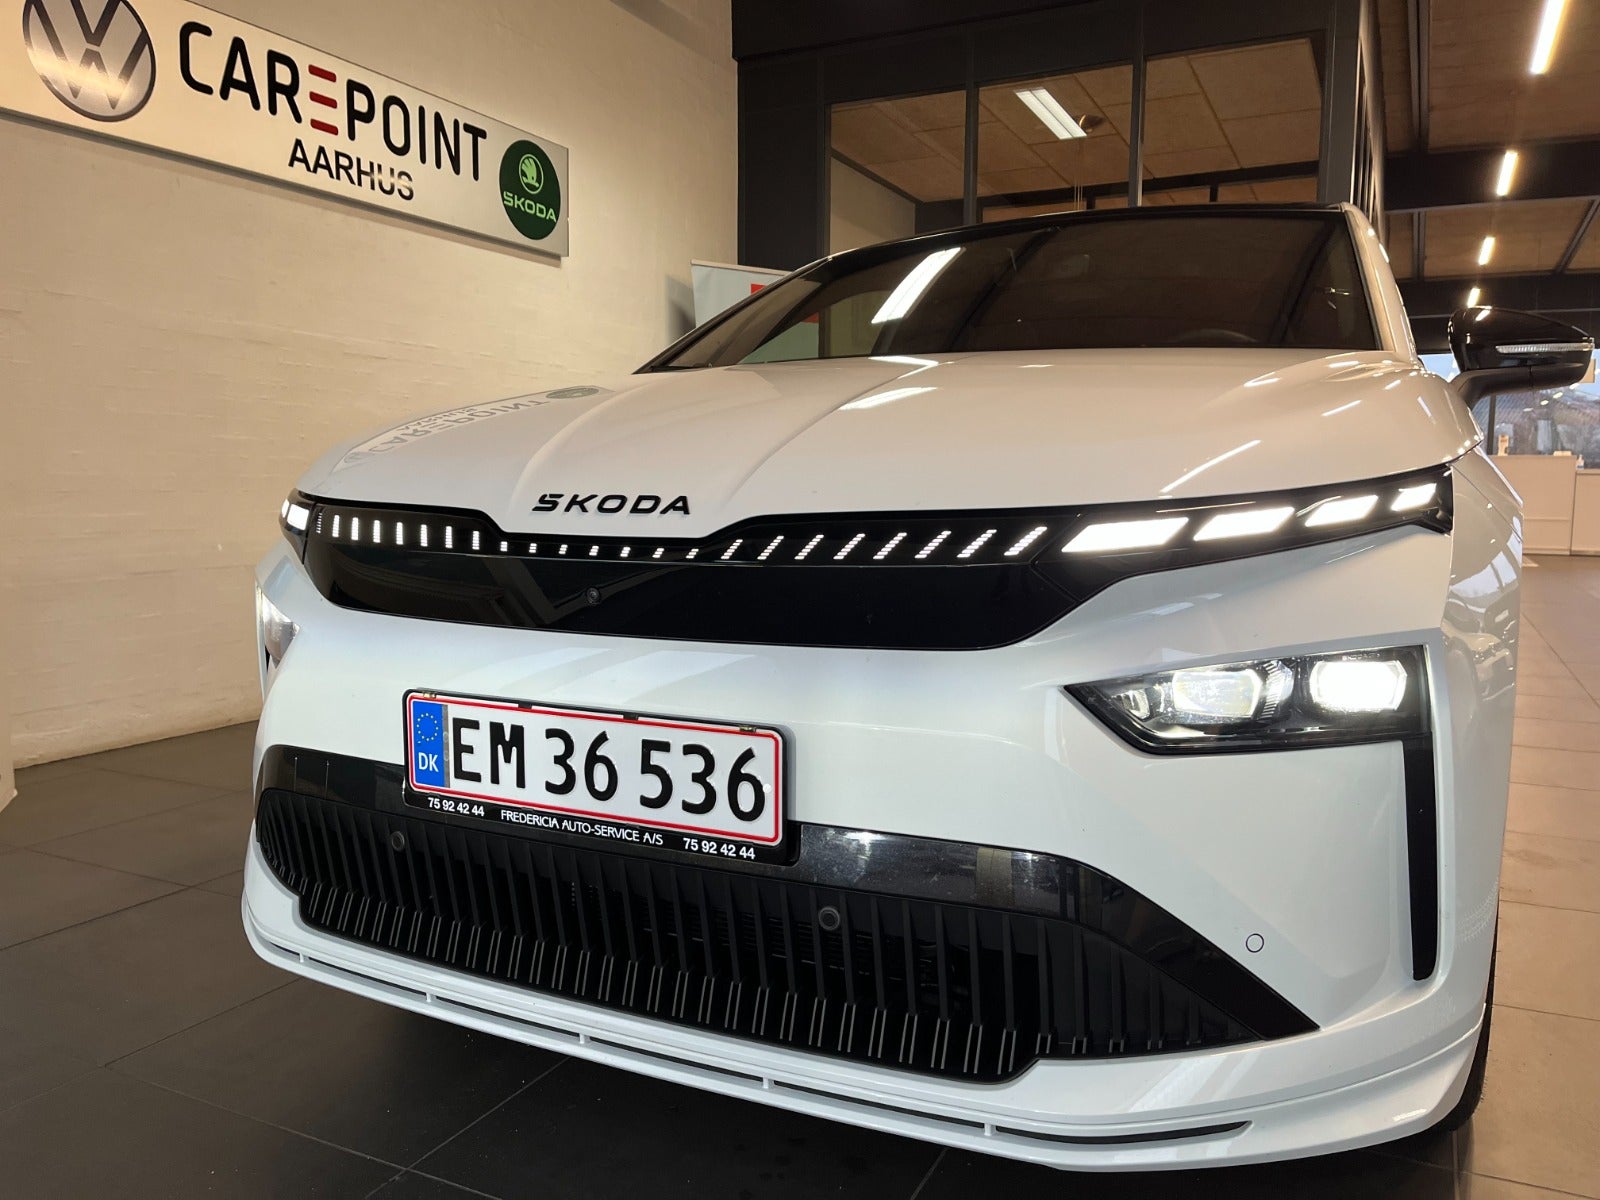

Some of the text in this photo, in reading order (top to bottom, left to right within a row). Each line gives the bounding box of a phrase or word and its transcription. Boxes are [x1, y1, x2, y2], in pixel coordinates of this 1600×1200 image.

[179, 21, 487, 182] CAREPOINT
[288, 138, 414, 201] AARHUS
[503, 191, 557, 223] SKODA
[531, 493, 691, 515] SKODA
[418, 751, 440, 773] DK
[452, 717, 766, 822] EM 36 536
[427, 797, 485, 817] 75 92 42 44
[501, 809, 664, 846] FREDERICIA AUTO-SERVICE A/S
[683, 837, 756, 860] 75 92 42 44
